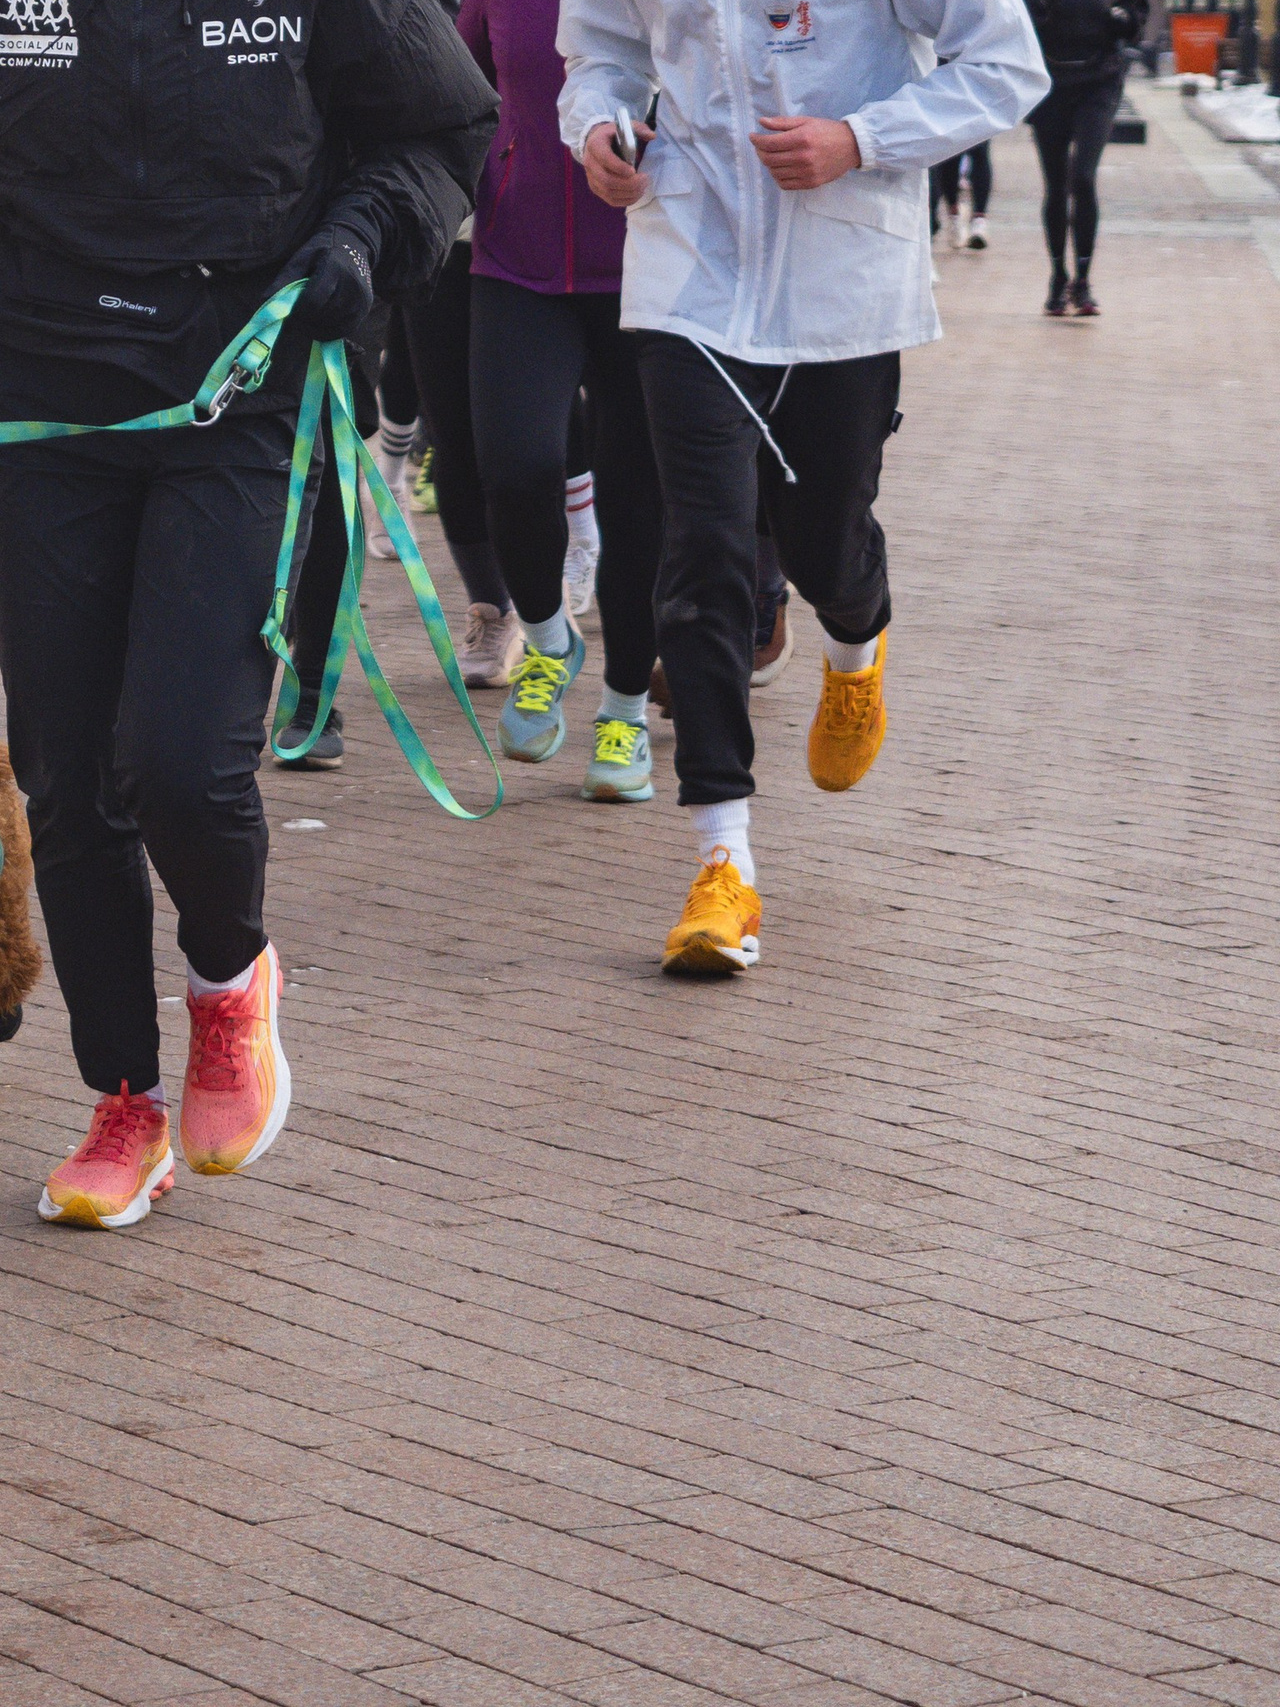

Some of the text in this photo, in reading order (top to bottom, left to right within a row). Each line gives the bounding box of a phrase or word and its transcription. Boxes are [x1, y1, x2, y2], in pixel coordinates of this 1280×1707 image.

[202, 15, 302, 47] BAON
[0, 40, 74, 51] SOCIAL RUN
[227, 52, 279, 65] SPORT
[121, 300, 157, 315] Kalenji
